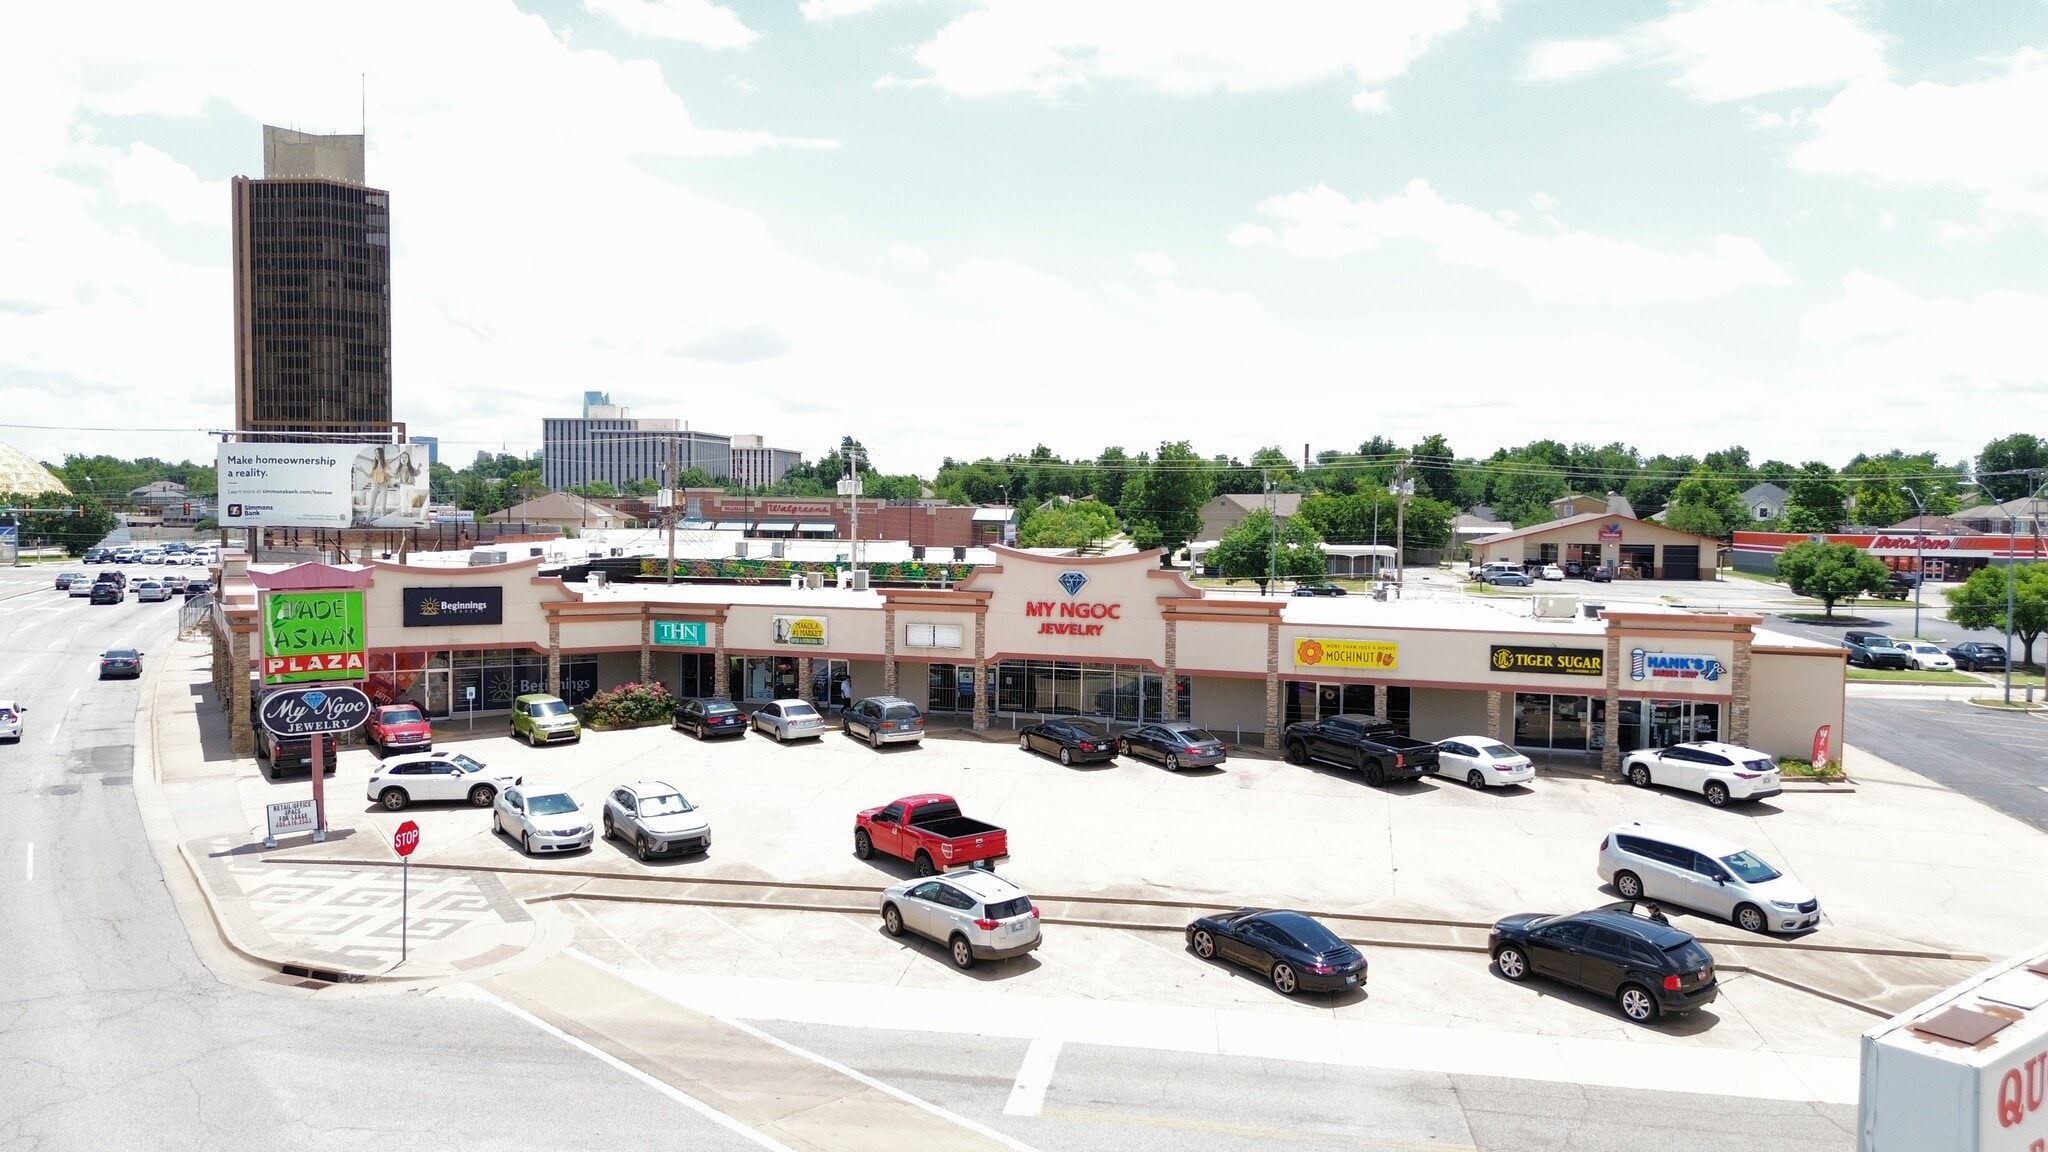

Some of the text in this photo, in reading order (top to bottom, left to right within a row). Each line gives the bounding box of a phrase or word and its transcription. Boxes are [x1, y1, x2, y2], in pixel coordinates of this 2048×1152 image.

[228, 455, 336, 467] Make homeownership
[236, 468, 268, 479] reality.
[768, 504, 829, 514] Walgreens
[1873, 536, 1950, 549] AutoZone
[441, 600, 487, 610] Beginnings
[1026, 602, 1121, 619] MY NGOC
[661, 623, 698, 640] THN
[1038, 623, 1104, 636] JEWELRY
[274, 626, 355, 649] ASIAN
[268, 654, 363, 673] PLAZA
[1326, 651, 1374, 662] MOCHINUT
[1515, 654, 1601, 669] TIGER SUGAR
[1648, 656, 1704, 670] HANK'S
[520, 678, 590, 692] Beginings
[267, 696, 366, 723] My Ngoc
[287, 719, 350, 732] JEWELRY
[395, 829, 419, 848] STOP
[1997, 1051, 2048, 1128] QU
